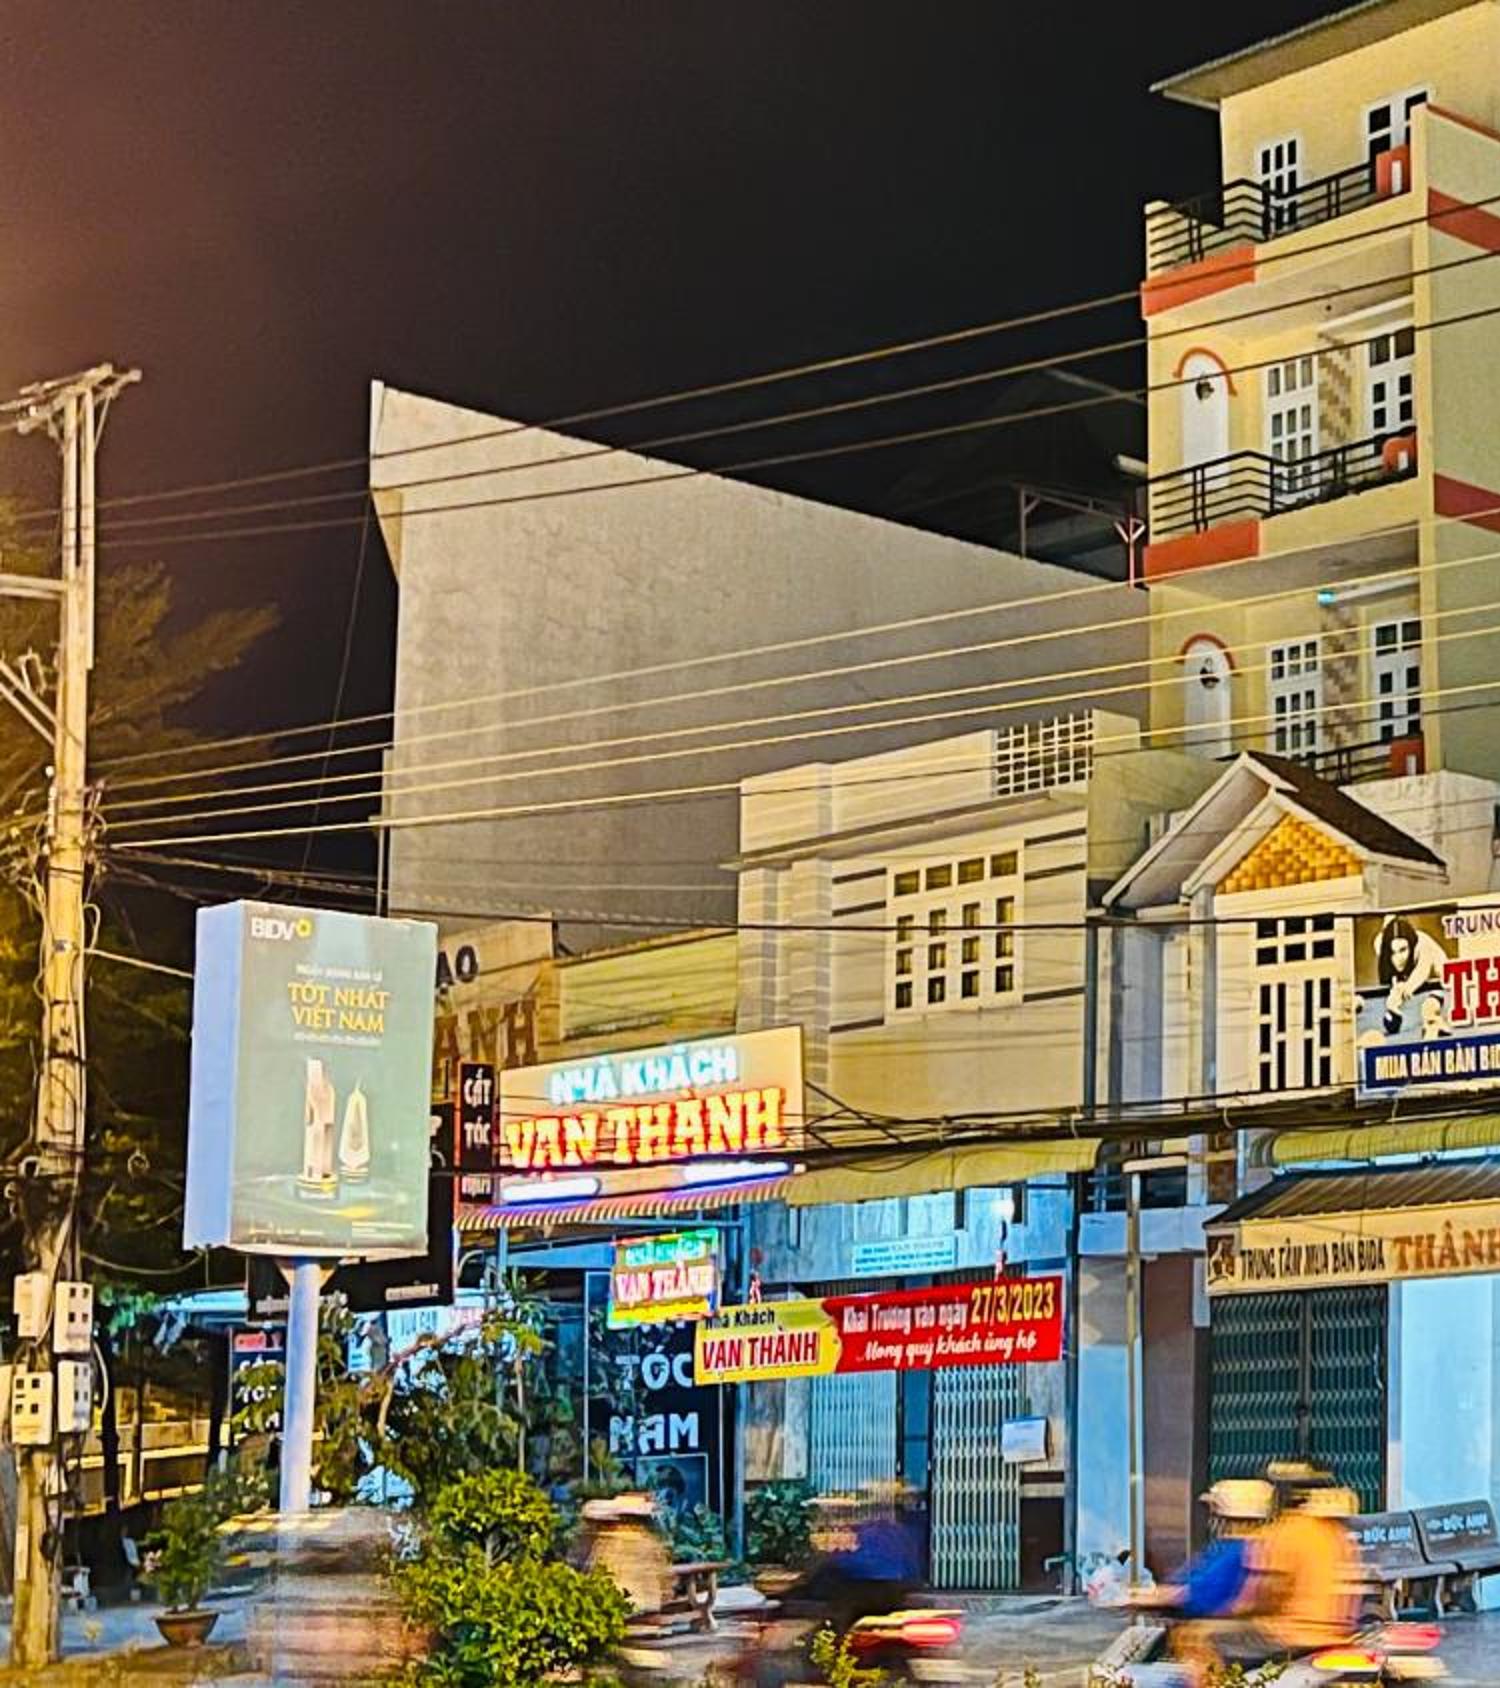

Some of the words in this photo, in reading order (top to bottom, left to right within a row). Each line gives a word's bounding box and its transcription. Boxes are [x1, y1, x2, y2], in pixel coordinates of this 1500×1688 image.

[250, 916, 295, 940] BIDV
[288, 979, 332, 1004] TỐT
[334, 984, 393, 1010] NHẤT
[291, 1003, 336, 1030] VIỆT
[338, 1009, 385, 1033] NAM
[549, 1056, 619, 1105] NHÀ
[621, 1044, 739, 1097] KHÁCH
[1374, 1053, 1408, 1081] MUA
[1411, 1045, 1442, 1077] BÁN
[1445, 1042, 1476, 1074] BÀN
[463, 1115, 491, 1149] TÓC
[504, 1111, 600, 1178] VẠN
[606, 1086, 787, 1164] THÀNH
[1240, 1247, 1277, 1281] TRUNG
[1279, 1236, 1301, 1279] TÂM
[1305, 1242, 1329, 1275] MUA
[1357, 1237, 1386, 1272] BIDA
[704, 1313, 730, 1330] Nhà
[735, 1307, 775, 1327] Khách
[843, 1304, 869, 1333] Khai
[914, 1301, 935, 1328] vào
[939, 1296, 969, 1330] ngày
[971, 1281, 1055, 1326] 27/3/2023
[615, 1344, 693, 1391] TÓC
[702, 1337, 742, 1377] VẠN
[747, 1325, 819, 1366] THÀNH
[864, 1341, 903, 1367] Mong
[936, 1331, 982, 1354] khách
[609, 1411, 699, 1455] NAM
